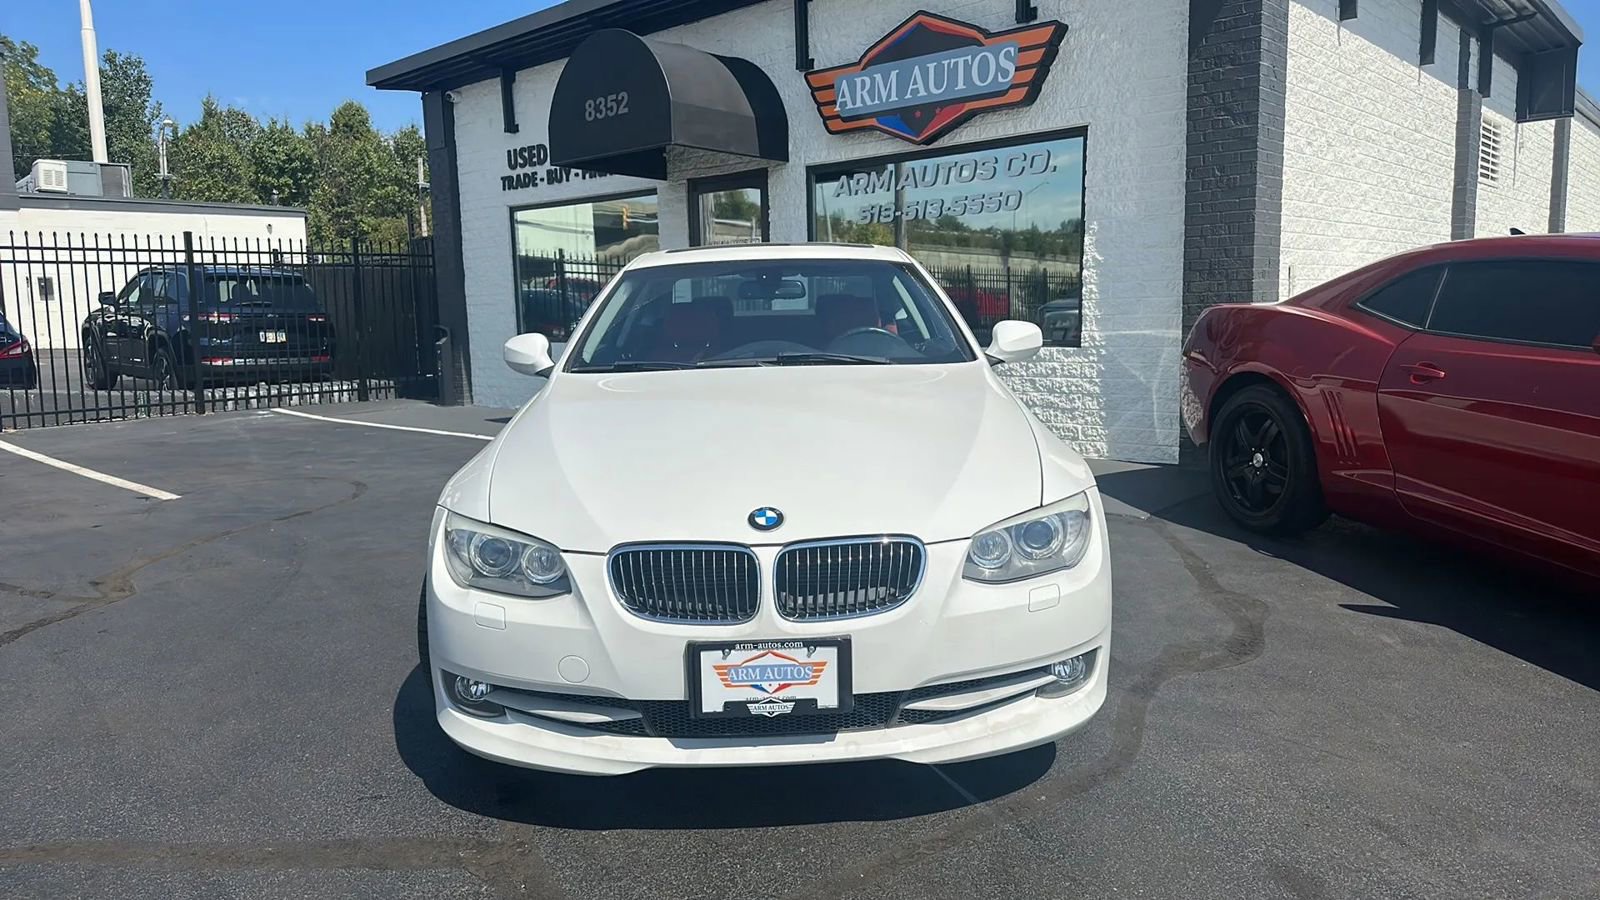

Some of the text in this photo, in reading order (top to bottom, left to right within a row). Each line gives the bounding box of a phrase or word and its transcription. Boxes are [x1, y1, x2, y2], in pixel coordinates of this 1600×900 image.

[835, 46, 1016, 112] ARM AUTOS
[585, 91, 629, 121] 8352
[507, 144, 548, 170] USED
[501, 172, 538, 191] TRADE
[546, 168, 571, 185] BUY
[832, 149, 1058, 198] ARM AUTOS CO.
[735, 641, 803, 650] arm-autos.com
[728, 665, 813, 681] ARM AUTOS
